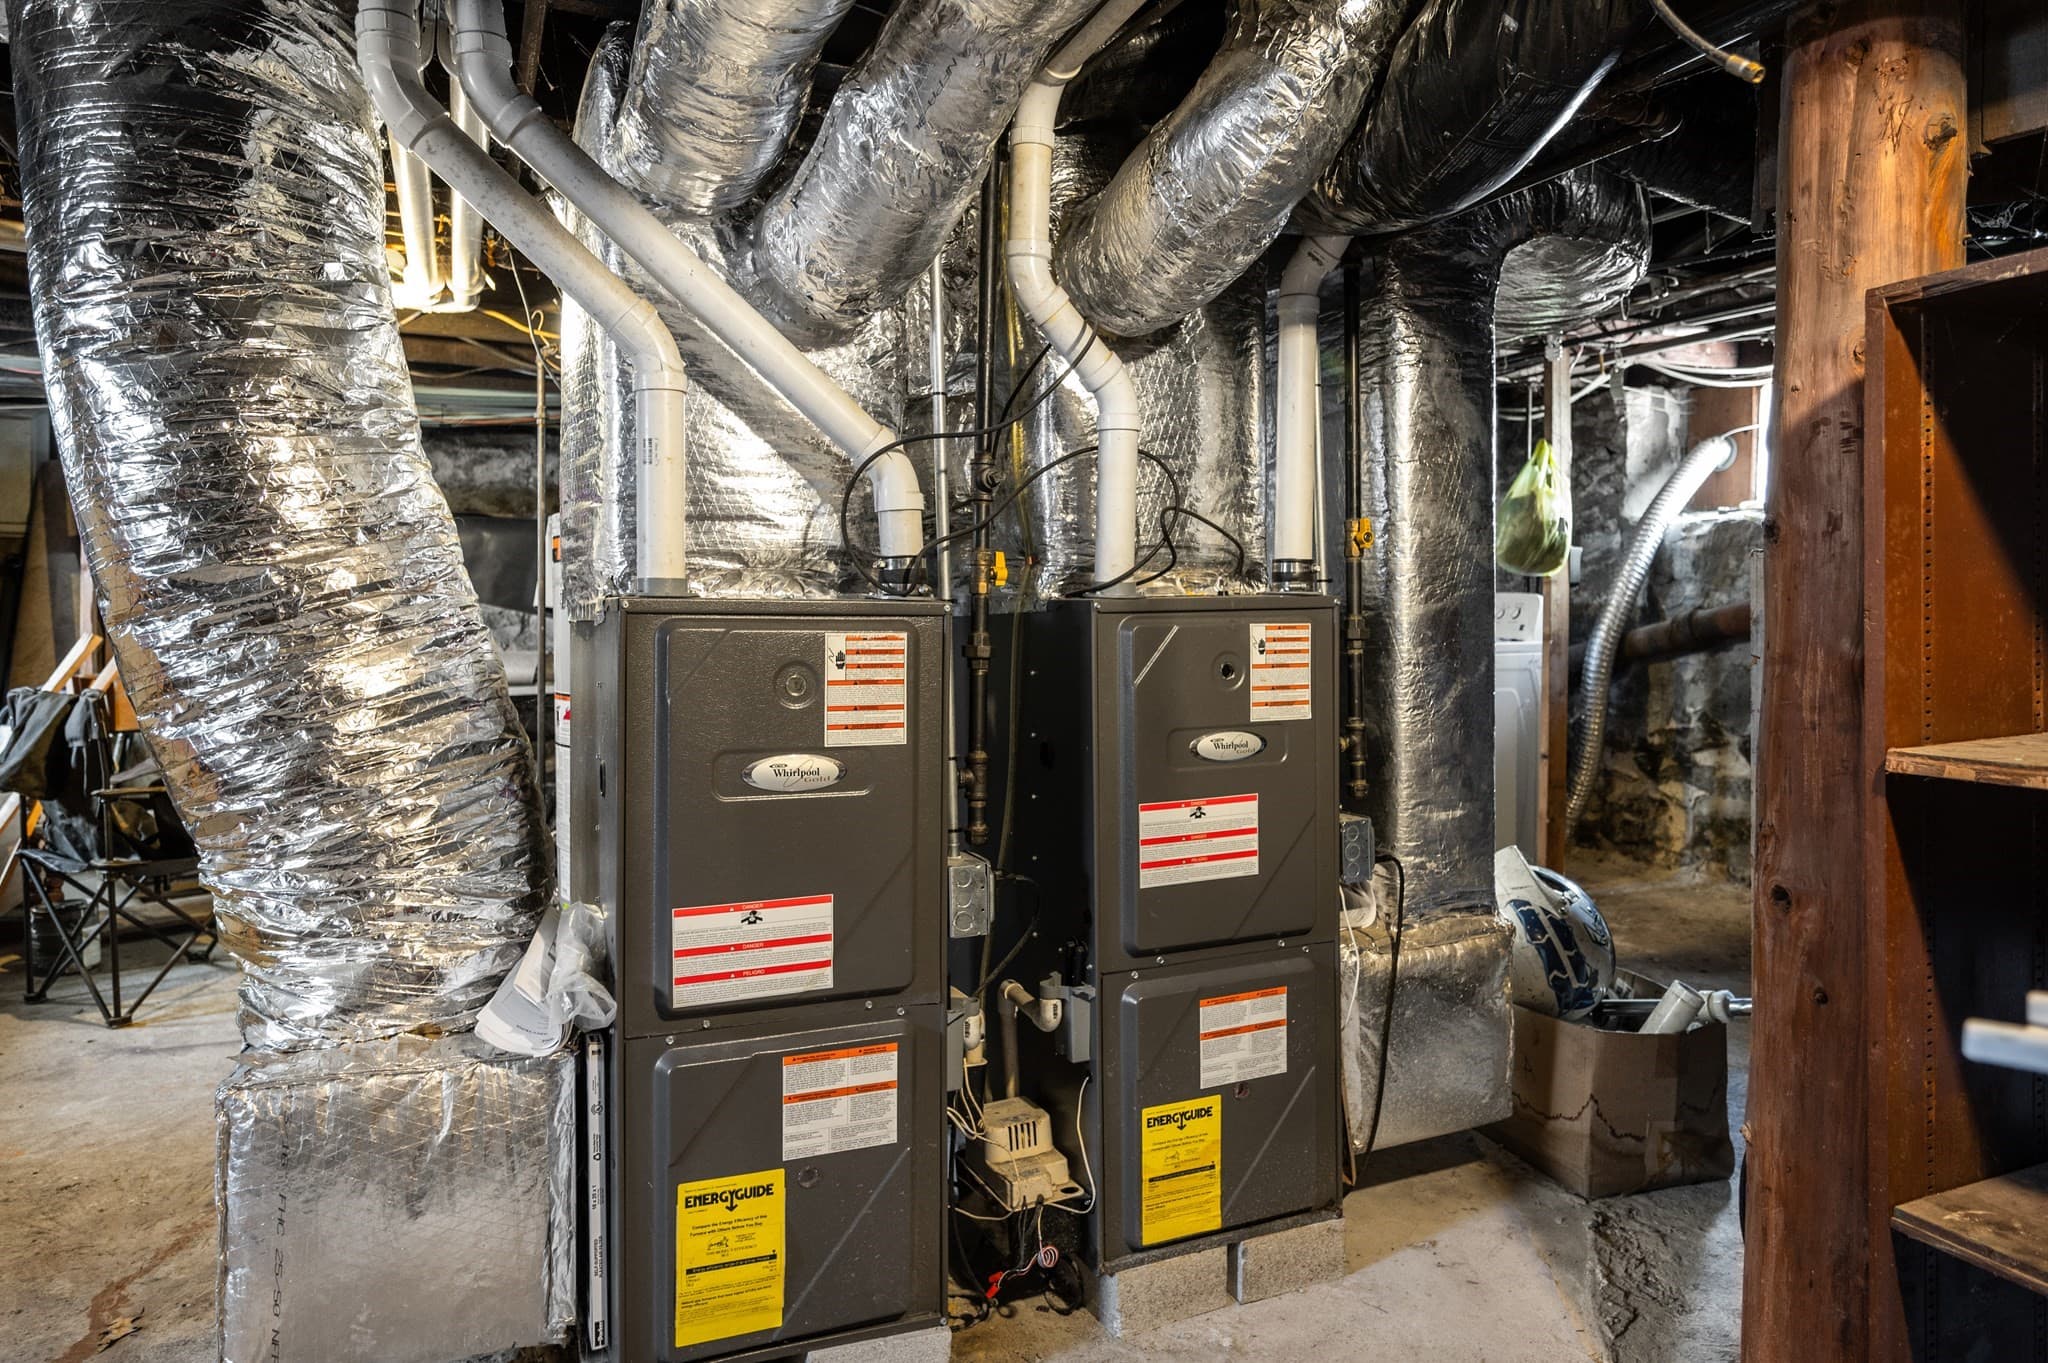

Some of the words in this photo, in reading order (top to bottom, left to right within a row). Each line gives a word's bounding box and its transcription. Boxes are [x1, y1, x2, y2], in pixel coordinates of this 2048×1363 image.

[1213, 740, 1249, 751] Whirlpool
[773, 767, 820, 779] Whirlpool
[742, 903, 764, 911] DANGER
[742, 942, 764, 950] DANGER
[742, 968, 765, 977] PELIGRO
[684, 1183, 774, 1211] ENERGYGUIDE
